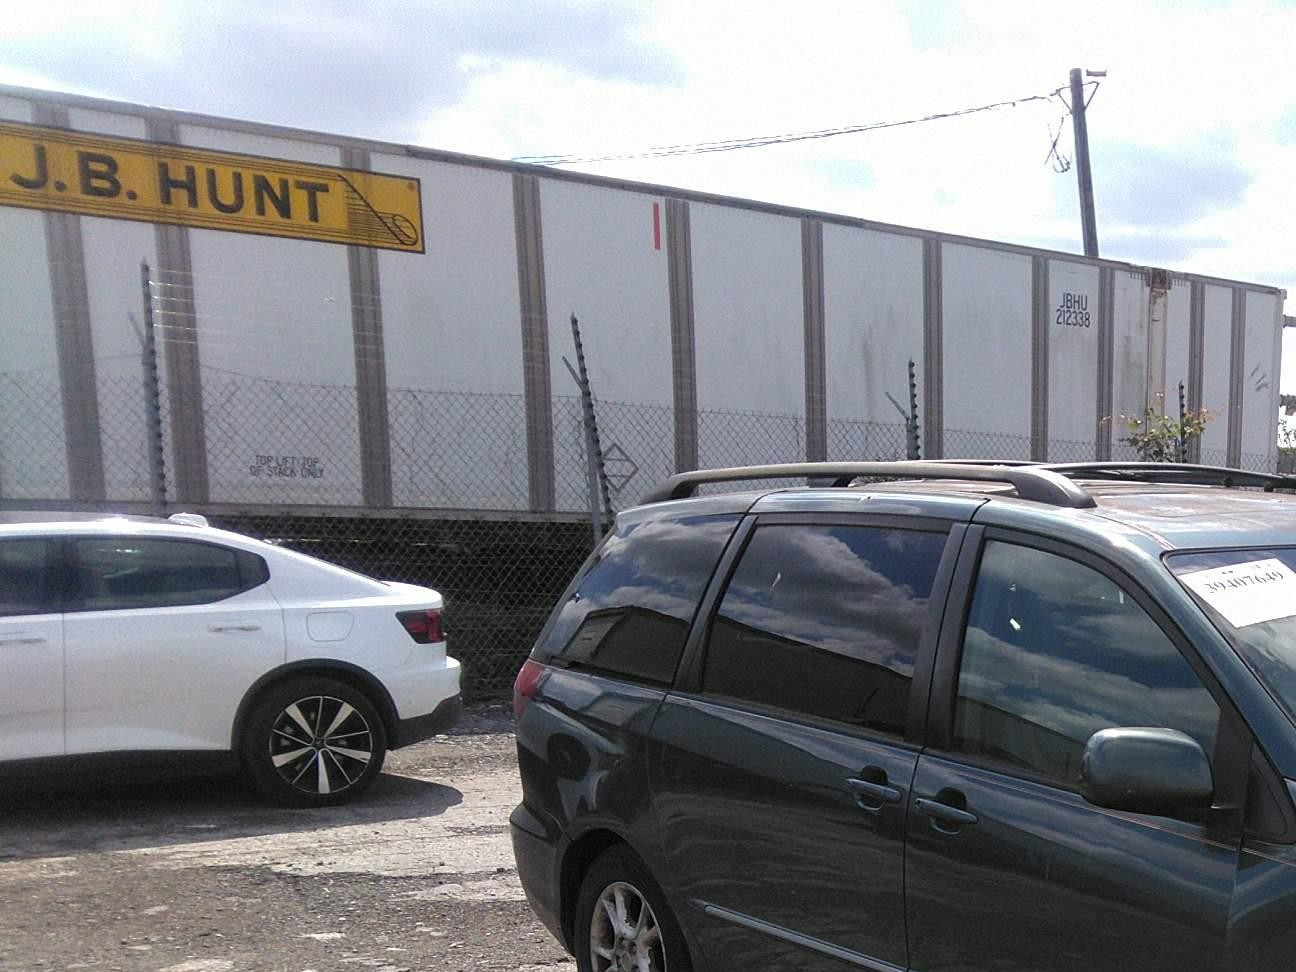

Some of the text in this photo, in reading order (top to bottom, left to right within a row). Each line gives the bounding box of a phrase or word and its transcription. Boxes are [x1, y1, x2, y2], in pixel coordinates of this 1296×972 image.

[157, 161, 329, 223] HUNT
[1059, 292, 1088, 311] JBHU
[1055, 308, 1091, 328] 212338
[255, 454, 274, 466] TOP
[1203, 571, 1285, 594] 39407649
